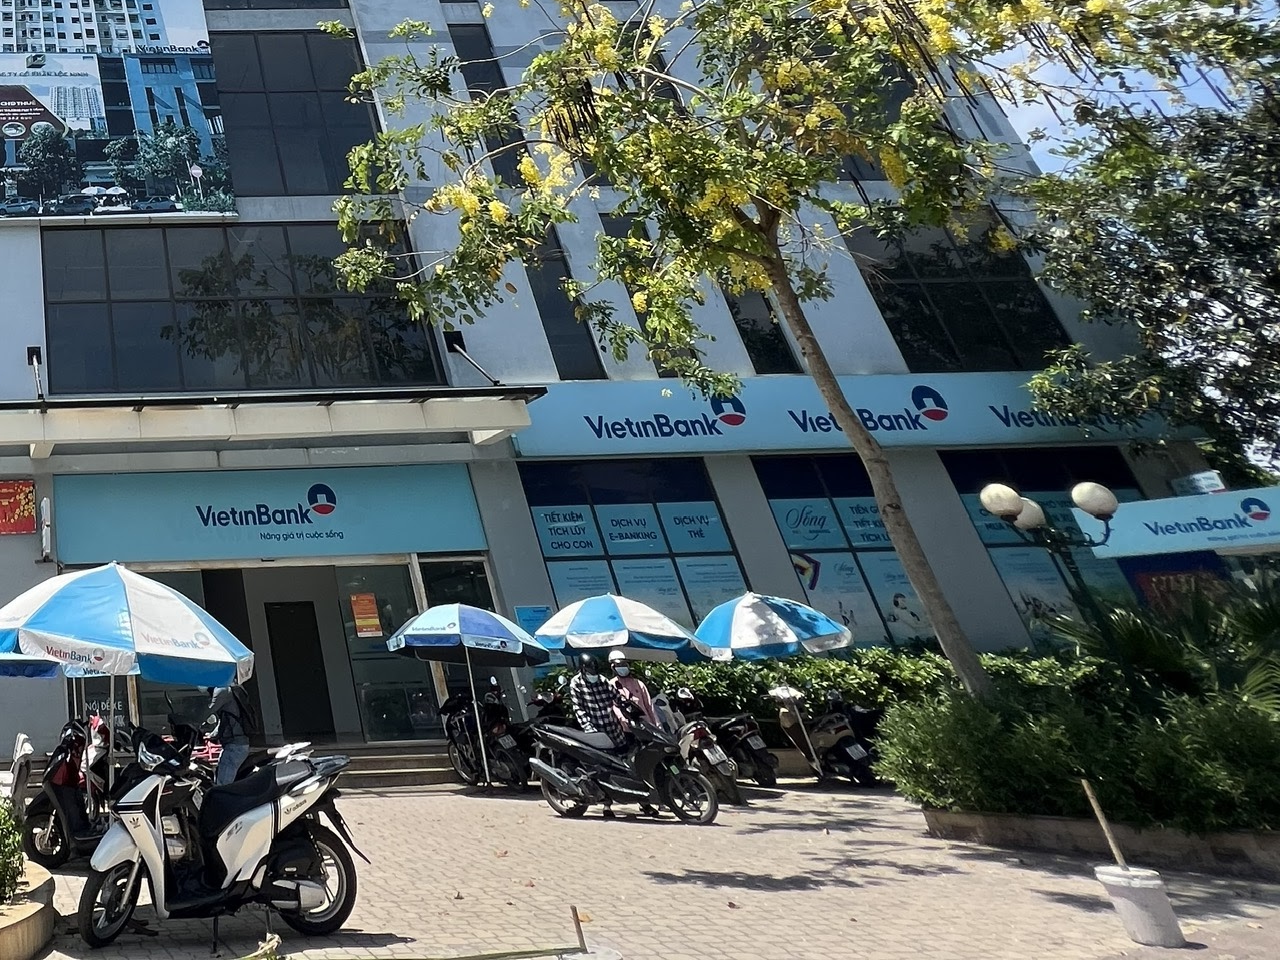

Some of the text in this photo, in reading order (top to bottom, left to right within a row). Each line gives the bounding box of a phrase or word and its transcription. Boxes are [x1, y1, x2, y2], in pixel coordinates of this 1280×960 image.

[584, 412, 724, 439] VietinBank
[787, 408, 928, 433] VietBank
[195, 503, 313, 527] VietinBank
[673, 514, 710, 527] DỊCH VỤ
[610, 518, 647, 529] DỊCH VỤ
[1142, 512, 1254, 537] VietinBank
[260, 530, 344, 542] Nâng giá trị cuộc sống
[609, 531, 658, 542] E-BANKING
[551, 541, 593, 550] CHO CON
[45, 645, 95, 665] VietinBank
